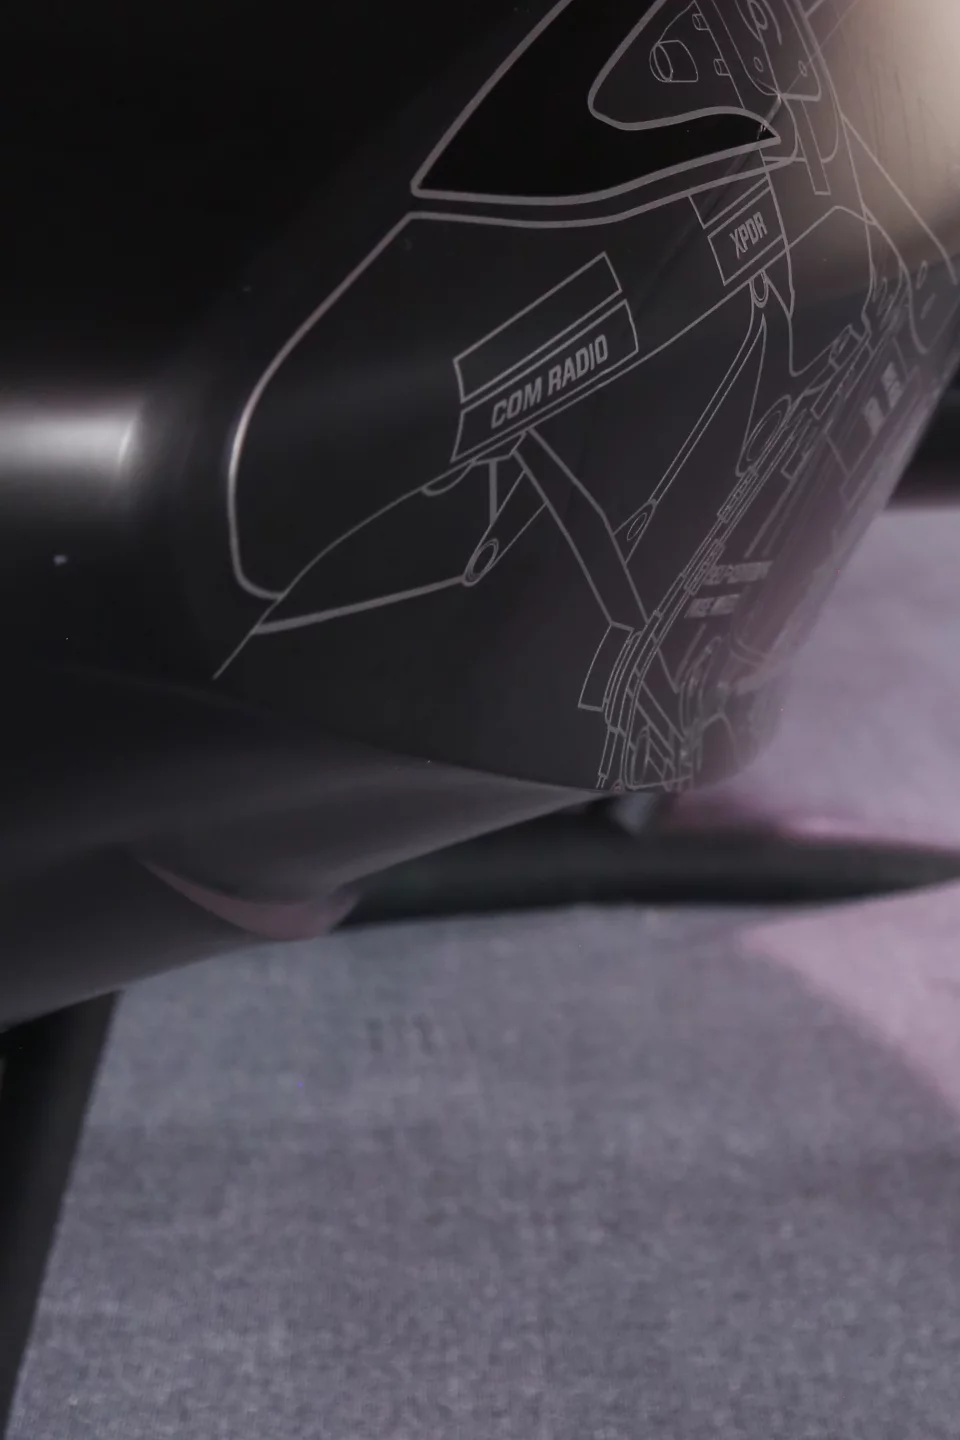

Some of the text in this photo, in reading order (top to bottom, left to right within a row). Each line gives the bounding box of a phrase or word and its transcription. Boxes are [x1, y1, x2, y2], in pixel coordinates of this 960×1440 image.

[729, 212, 768, 259] XPDR
[491, 334, 609, 429] COM RADIO
